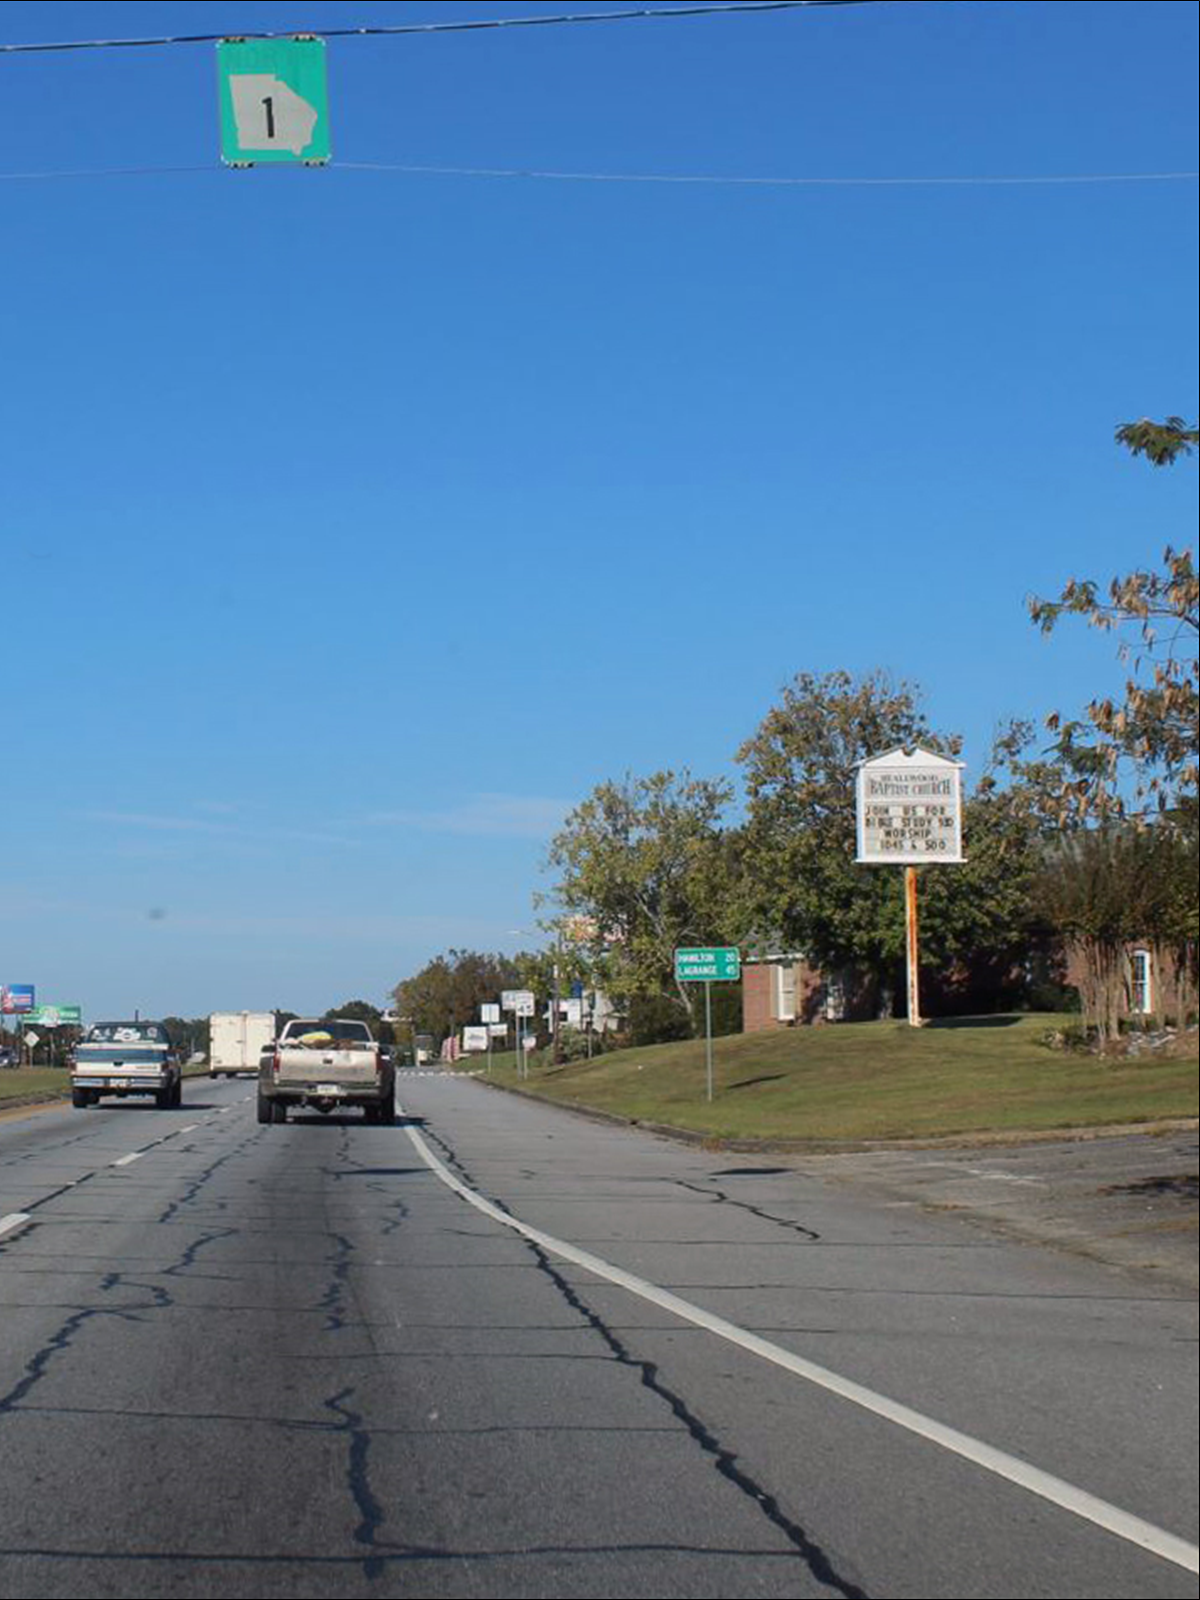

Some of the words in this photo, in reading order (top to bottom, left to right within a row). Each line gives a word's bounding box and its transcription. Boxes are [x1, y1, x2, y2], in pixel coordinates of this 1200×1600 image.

[261, 96, 275, 139] 1
[870, 778, 909, 795] BAPTIST
[913, 778, 951, 795] CHURCH
[865, 805, 889, 816] JOIN
[903, 805, 917, 816] US
[925, 805, 945, 816] FOR
[901, 817, 932, 828] STUDY
[883, 828, 932, 839] WORSHIP
[677, 952, 715, 963] HAMILTON
[725, 952, 735, 963] 20
[677, 964, 717, 976] LAGRANGE
